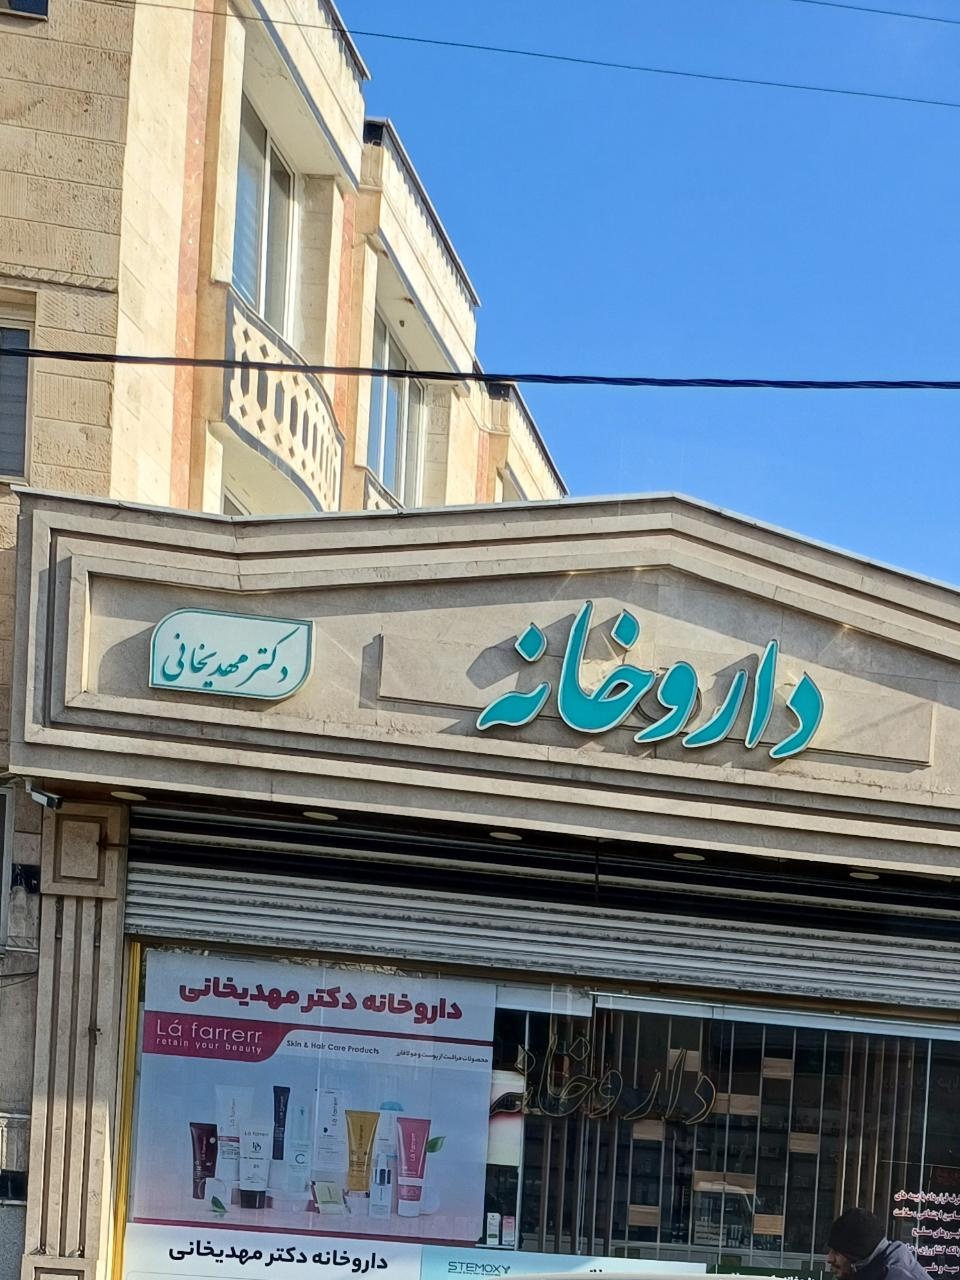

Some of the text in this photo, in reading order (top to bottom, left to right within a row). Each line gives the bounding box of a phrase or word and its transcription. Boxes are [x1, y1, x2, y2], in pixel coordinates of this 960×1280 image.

[162, 626, 300, 688] دکتر مهدیخانی
[476, 599, 825, 760] داروخانه
[179, 976, 463, 1024] داروخانه دکتر مهدیخانی
[156, 1019, 263, 1043] Lá farrerr
[156, 1037, 262, 1054] retain your beauty
[286, 1039, 380, 1055] Skin & Hair Care Products
[490, 1033, 716, 1125] داروخانه
[894, 1190, 908, 1201] های
[926, 1192, 949, 1204] قرارداد
[911, 1226, 960, 1240] نیروهای مسلح
[168, 1239, 389, 1274] داروخانه دکتر مهدیخانی
[945, 1245, 960, 1257] بانک
[447, 1261, 511, 1274] STEMOXY
